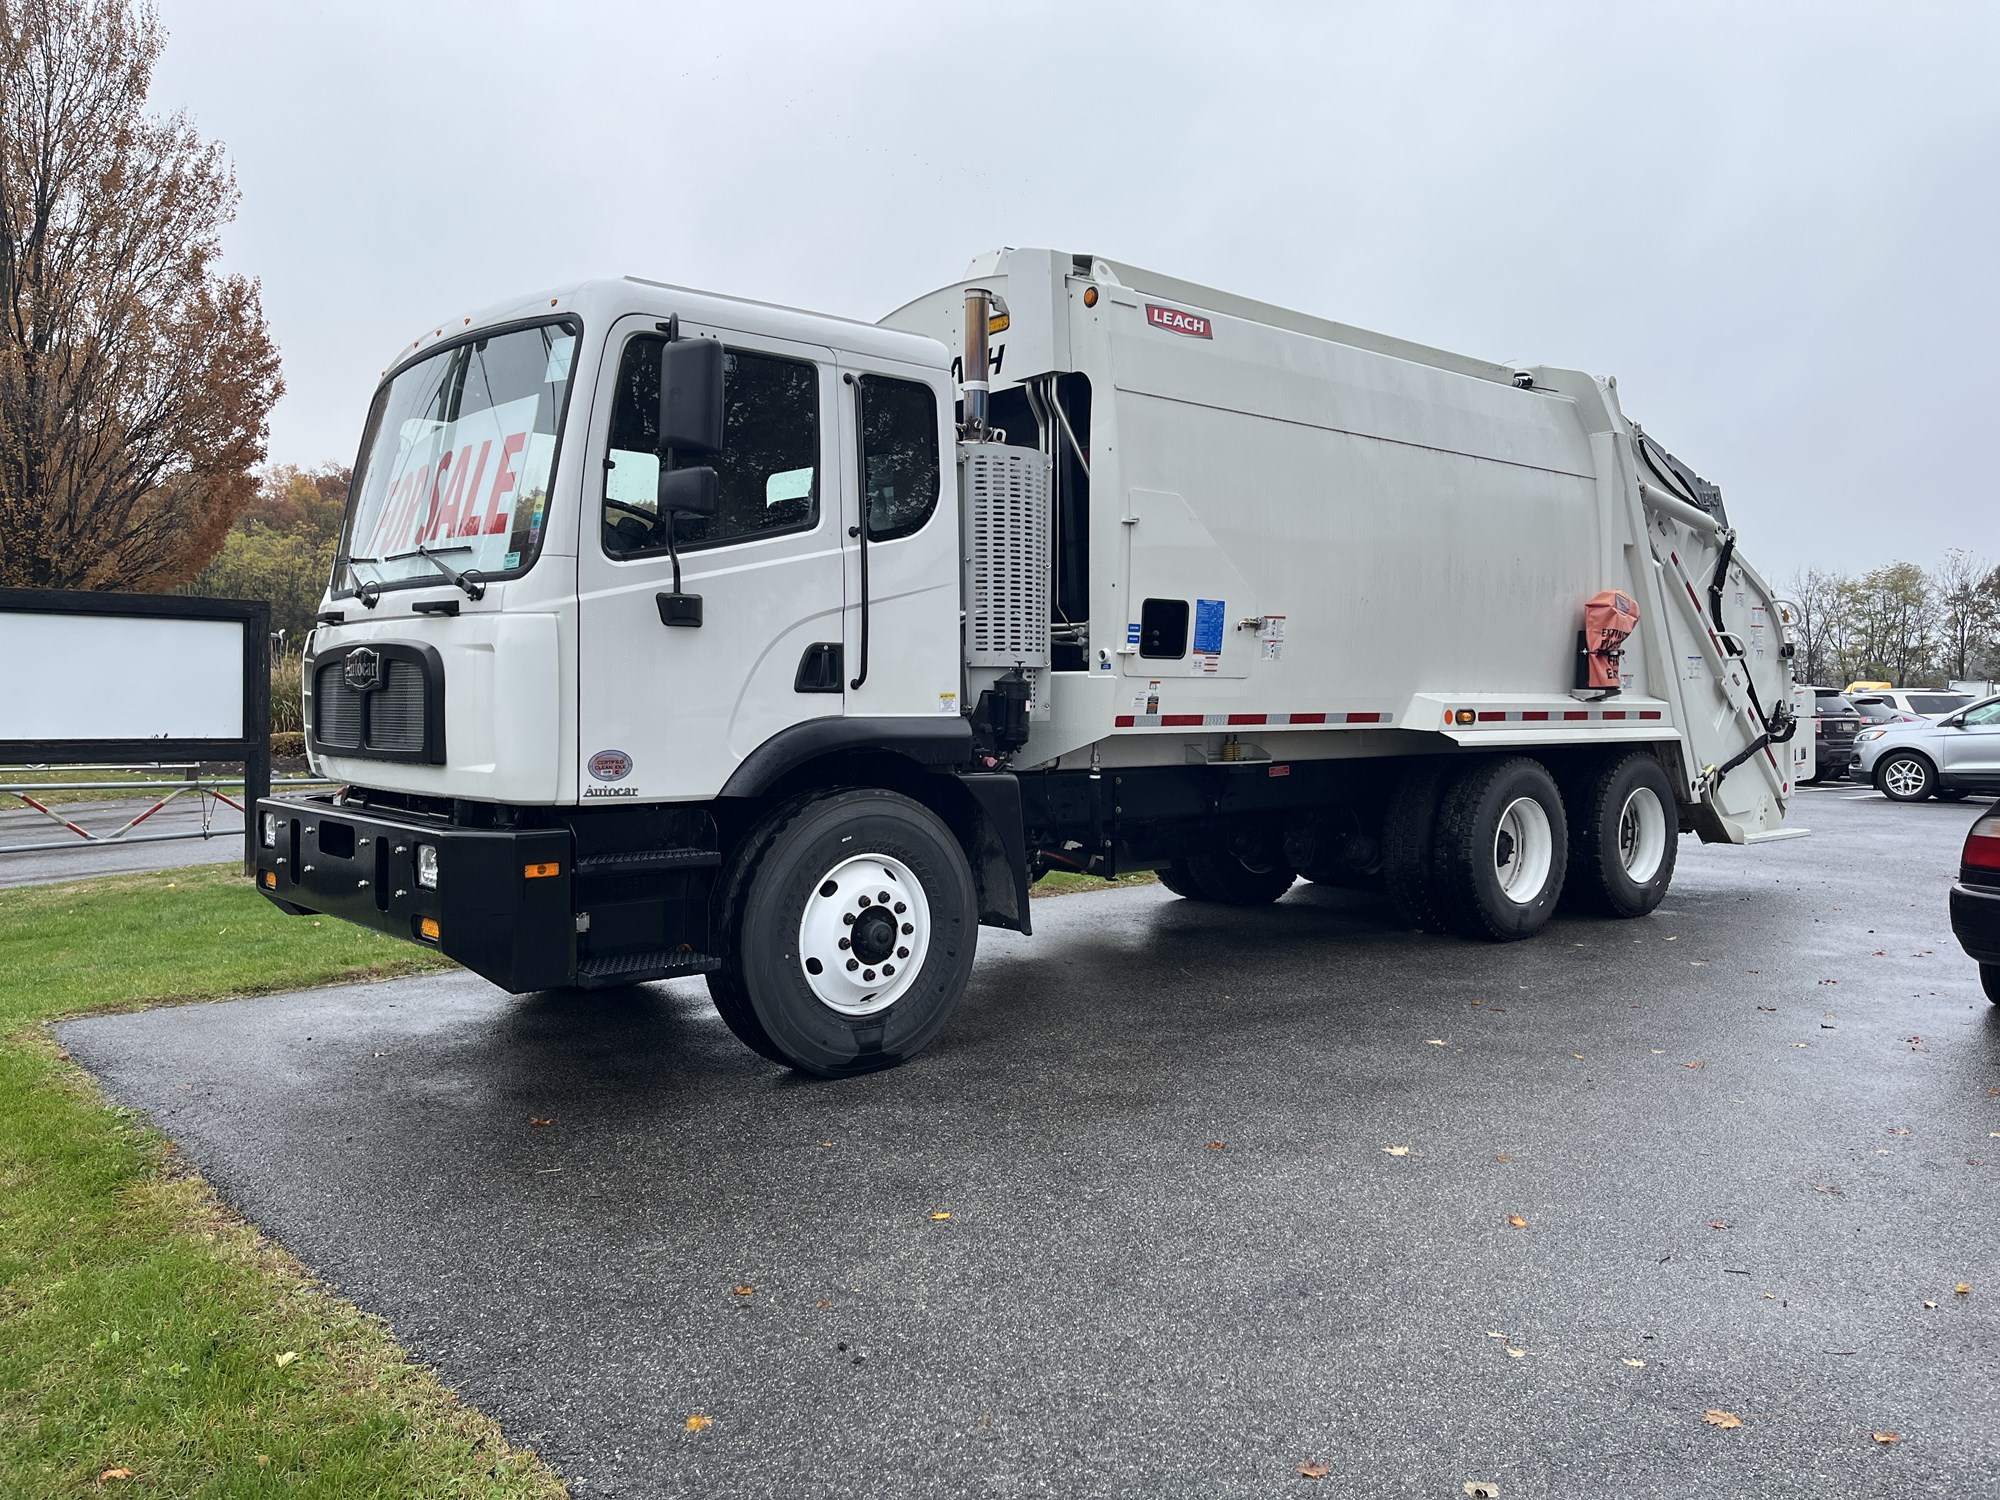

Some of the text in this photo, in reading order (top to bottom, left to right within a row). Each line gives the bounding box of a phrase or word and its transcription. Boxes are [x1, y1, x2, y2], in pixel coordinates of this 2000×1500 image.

[1154, 309, 1205, 333] LEACH
[366, 432, 527, 559] FOR SALE
[345, 657, 376, 677] Autocar
[583, 784, 639, 798] Autocar
